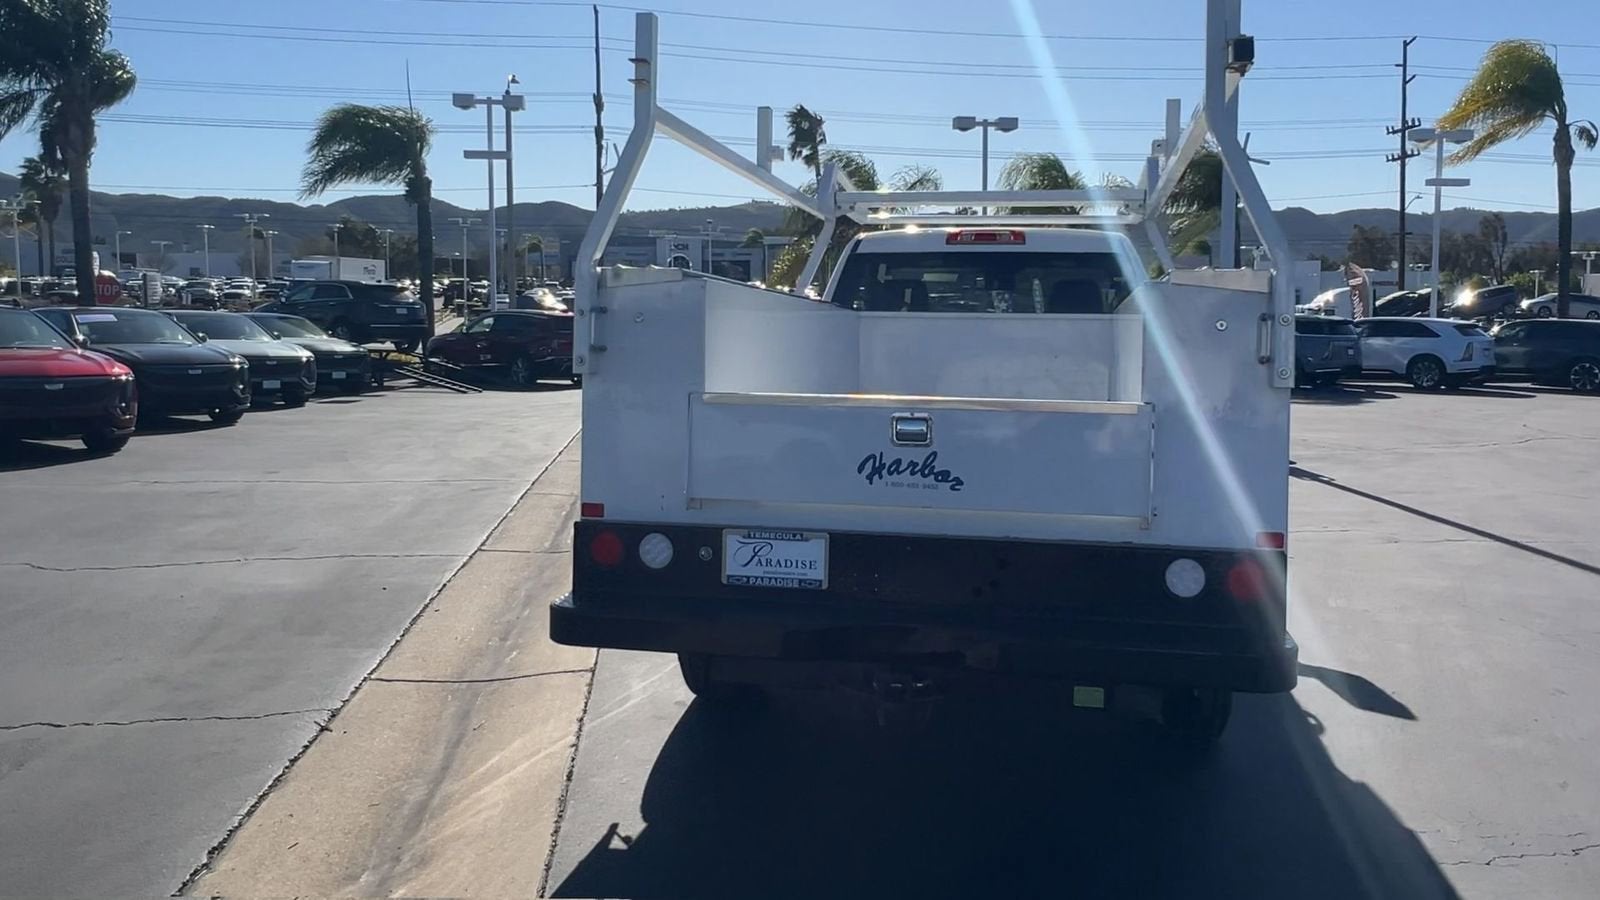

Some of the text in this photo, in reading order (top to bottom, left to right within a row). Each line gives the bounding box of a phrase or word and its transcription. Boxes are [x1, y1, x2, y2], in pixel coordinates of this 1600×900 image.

[97, 284, 119, 296] TOP
[857, 451, 964, 491] Harbor
[749, 531, 802, 540] TEMECULA
[734, 539, 818, 570] PARADISE
[748, 577, 800, 588] PARADISE
